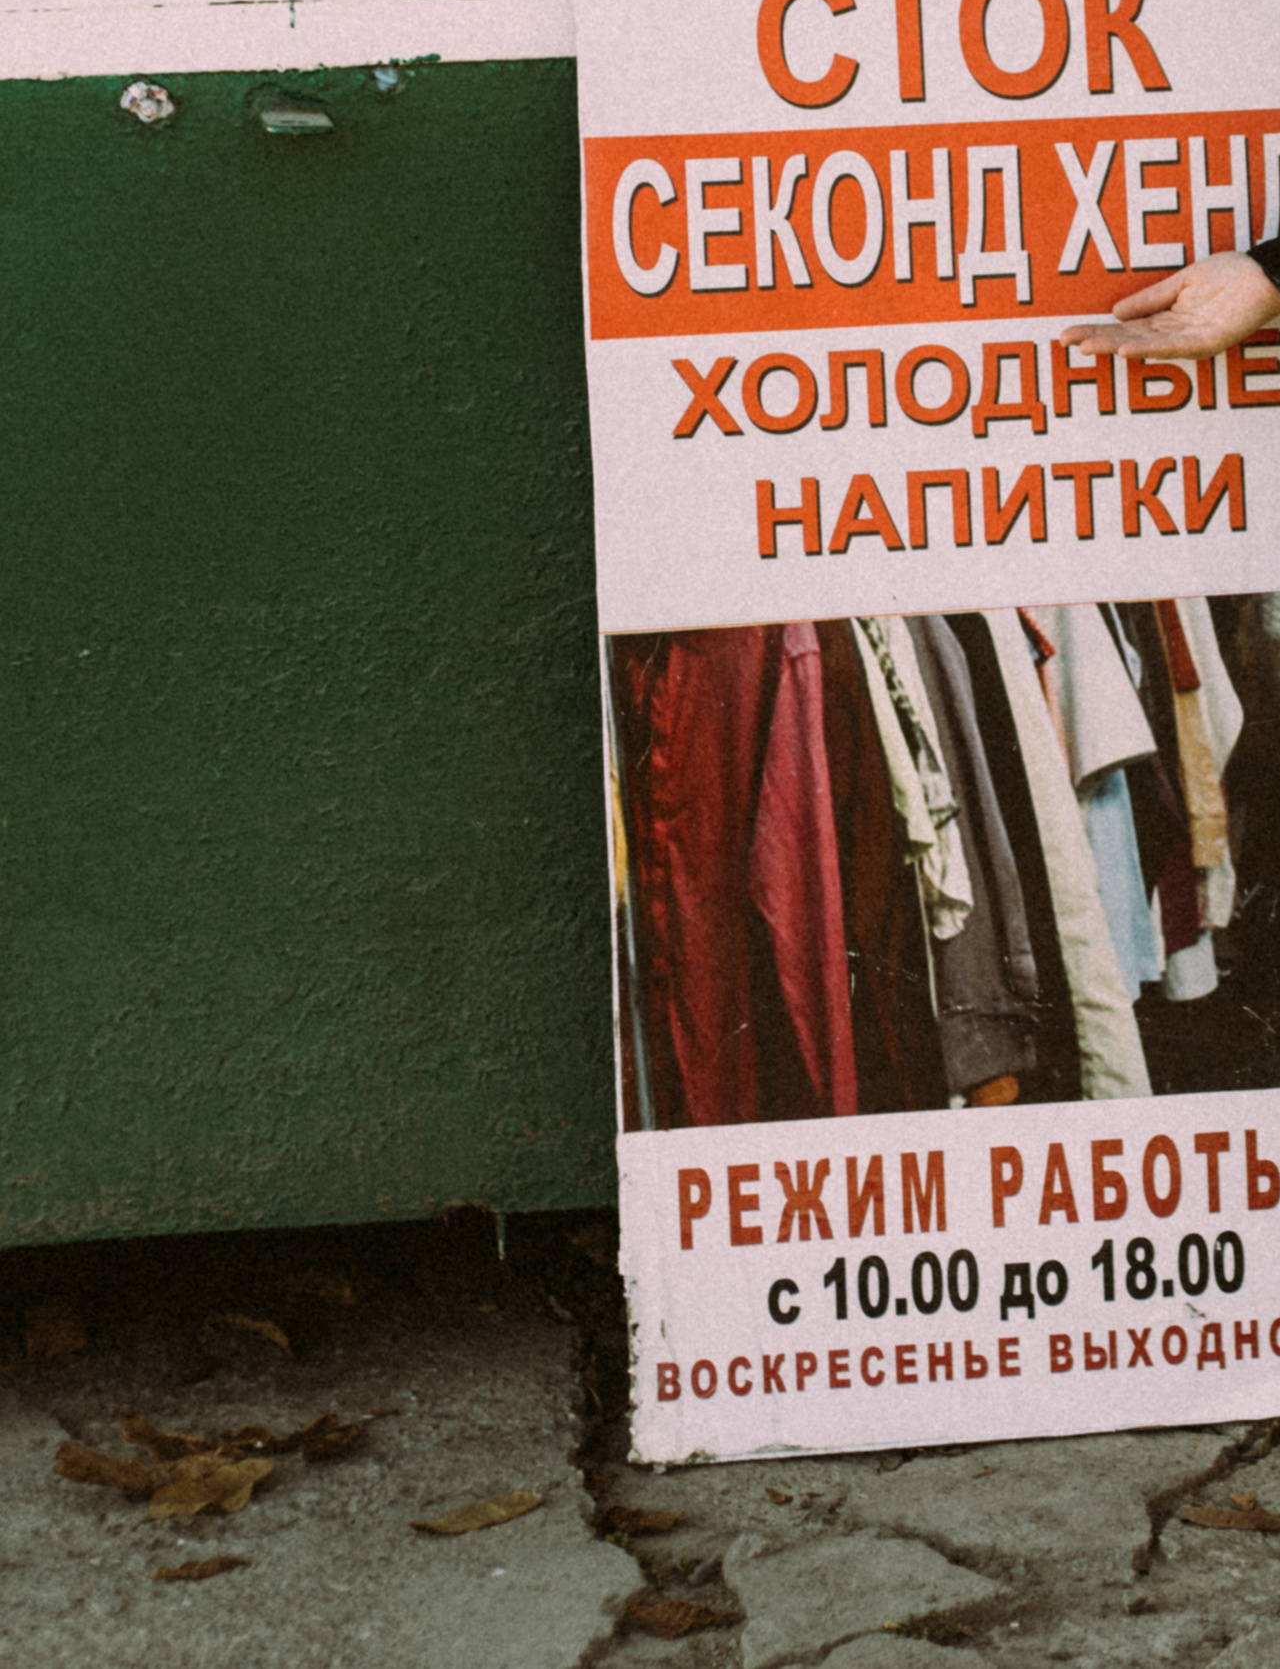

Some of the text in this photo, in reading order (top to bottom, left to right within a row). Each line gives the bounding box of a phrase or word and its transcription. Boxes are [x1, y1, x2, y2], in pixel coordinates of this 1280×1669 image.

[612, 143, 1032, 306] СЕКОНД
[755, 452, 1248, 559] НАПИТКИ
[677, 1149, 948, 1250] РЕЖИМ
[767, 1230, 1246, 1325] с 10.00 до 18.00
[656, 1336, 1021, 1403] ВОСКРЕСЕНЬЕ
